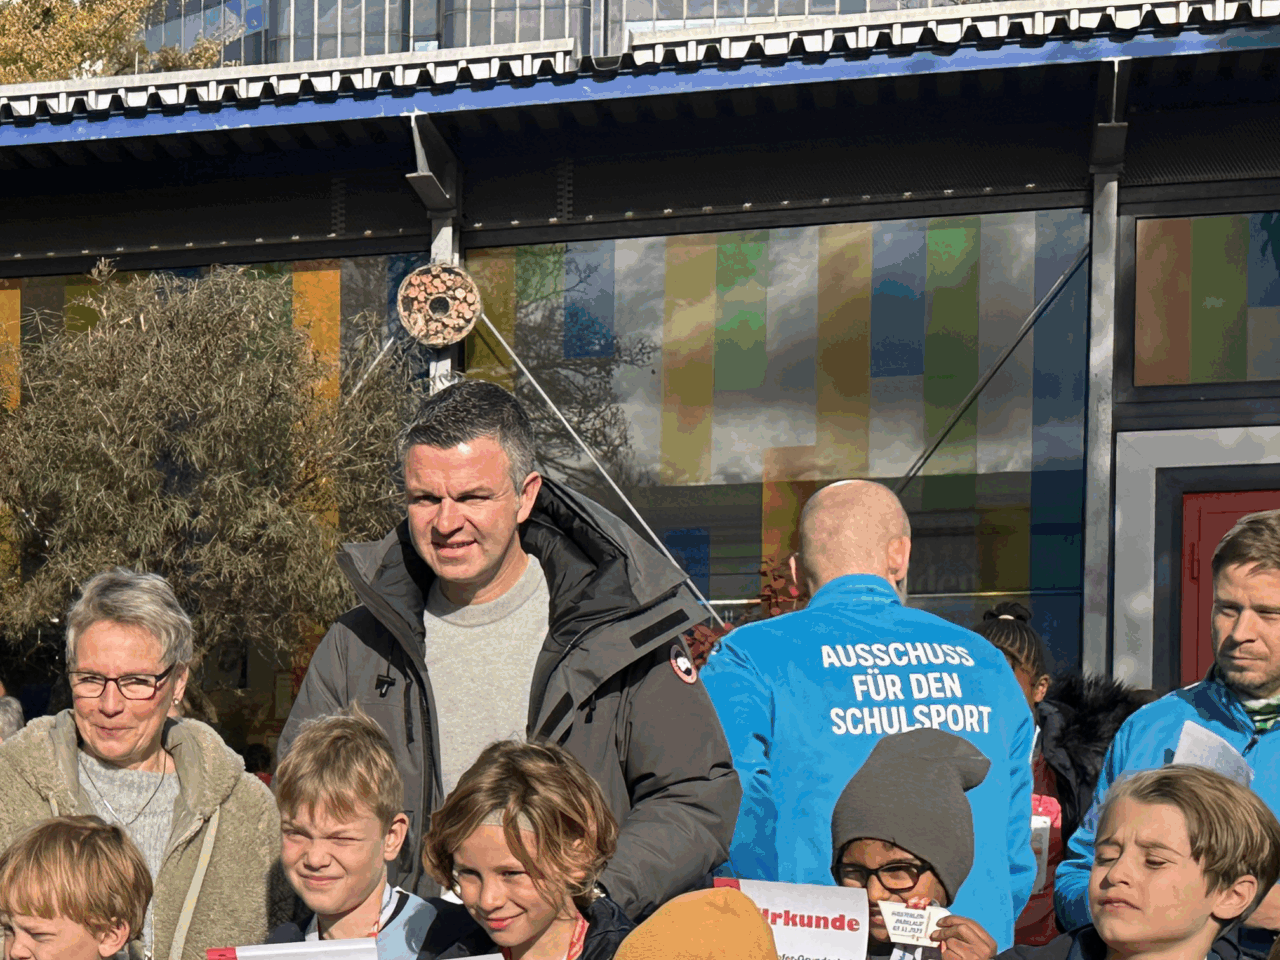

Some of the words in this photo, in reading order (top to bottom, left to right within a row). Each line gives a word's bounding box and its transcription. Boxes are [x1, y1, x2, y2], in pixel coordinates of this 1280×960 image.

[821, 642, 975, 668] AUSSCHUSS
[852, 668, 905, 701] FÜR
[909, 672, 962, 699] DEN
[830, 704, 992, 735] SCHULSPORT
